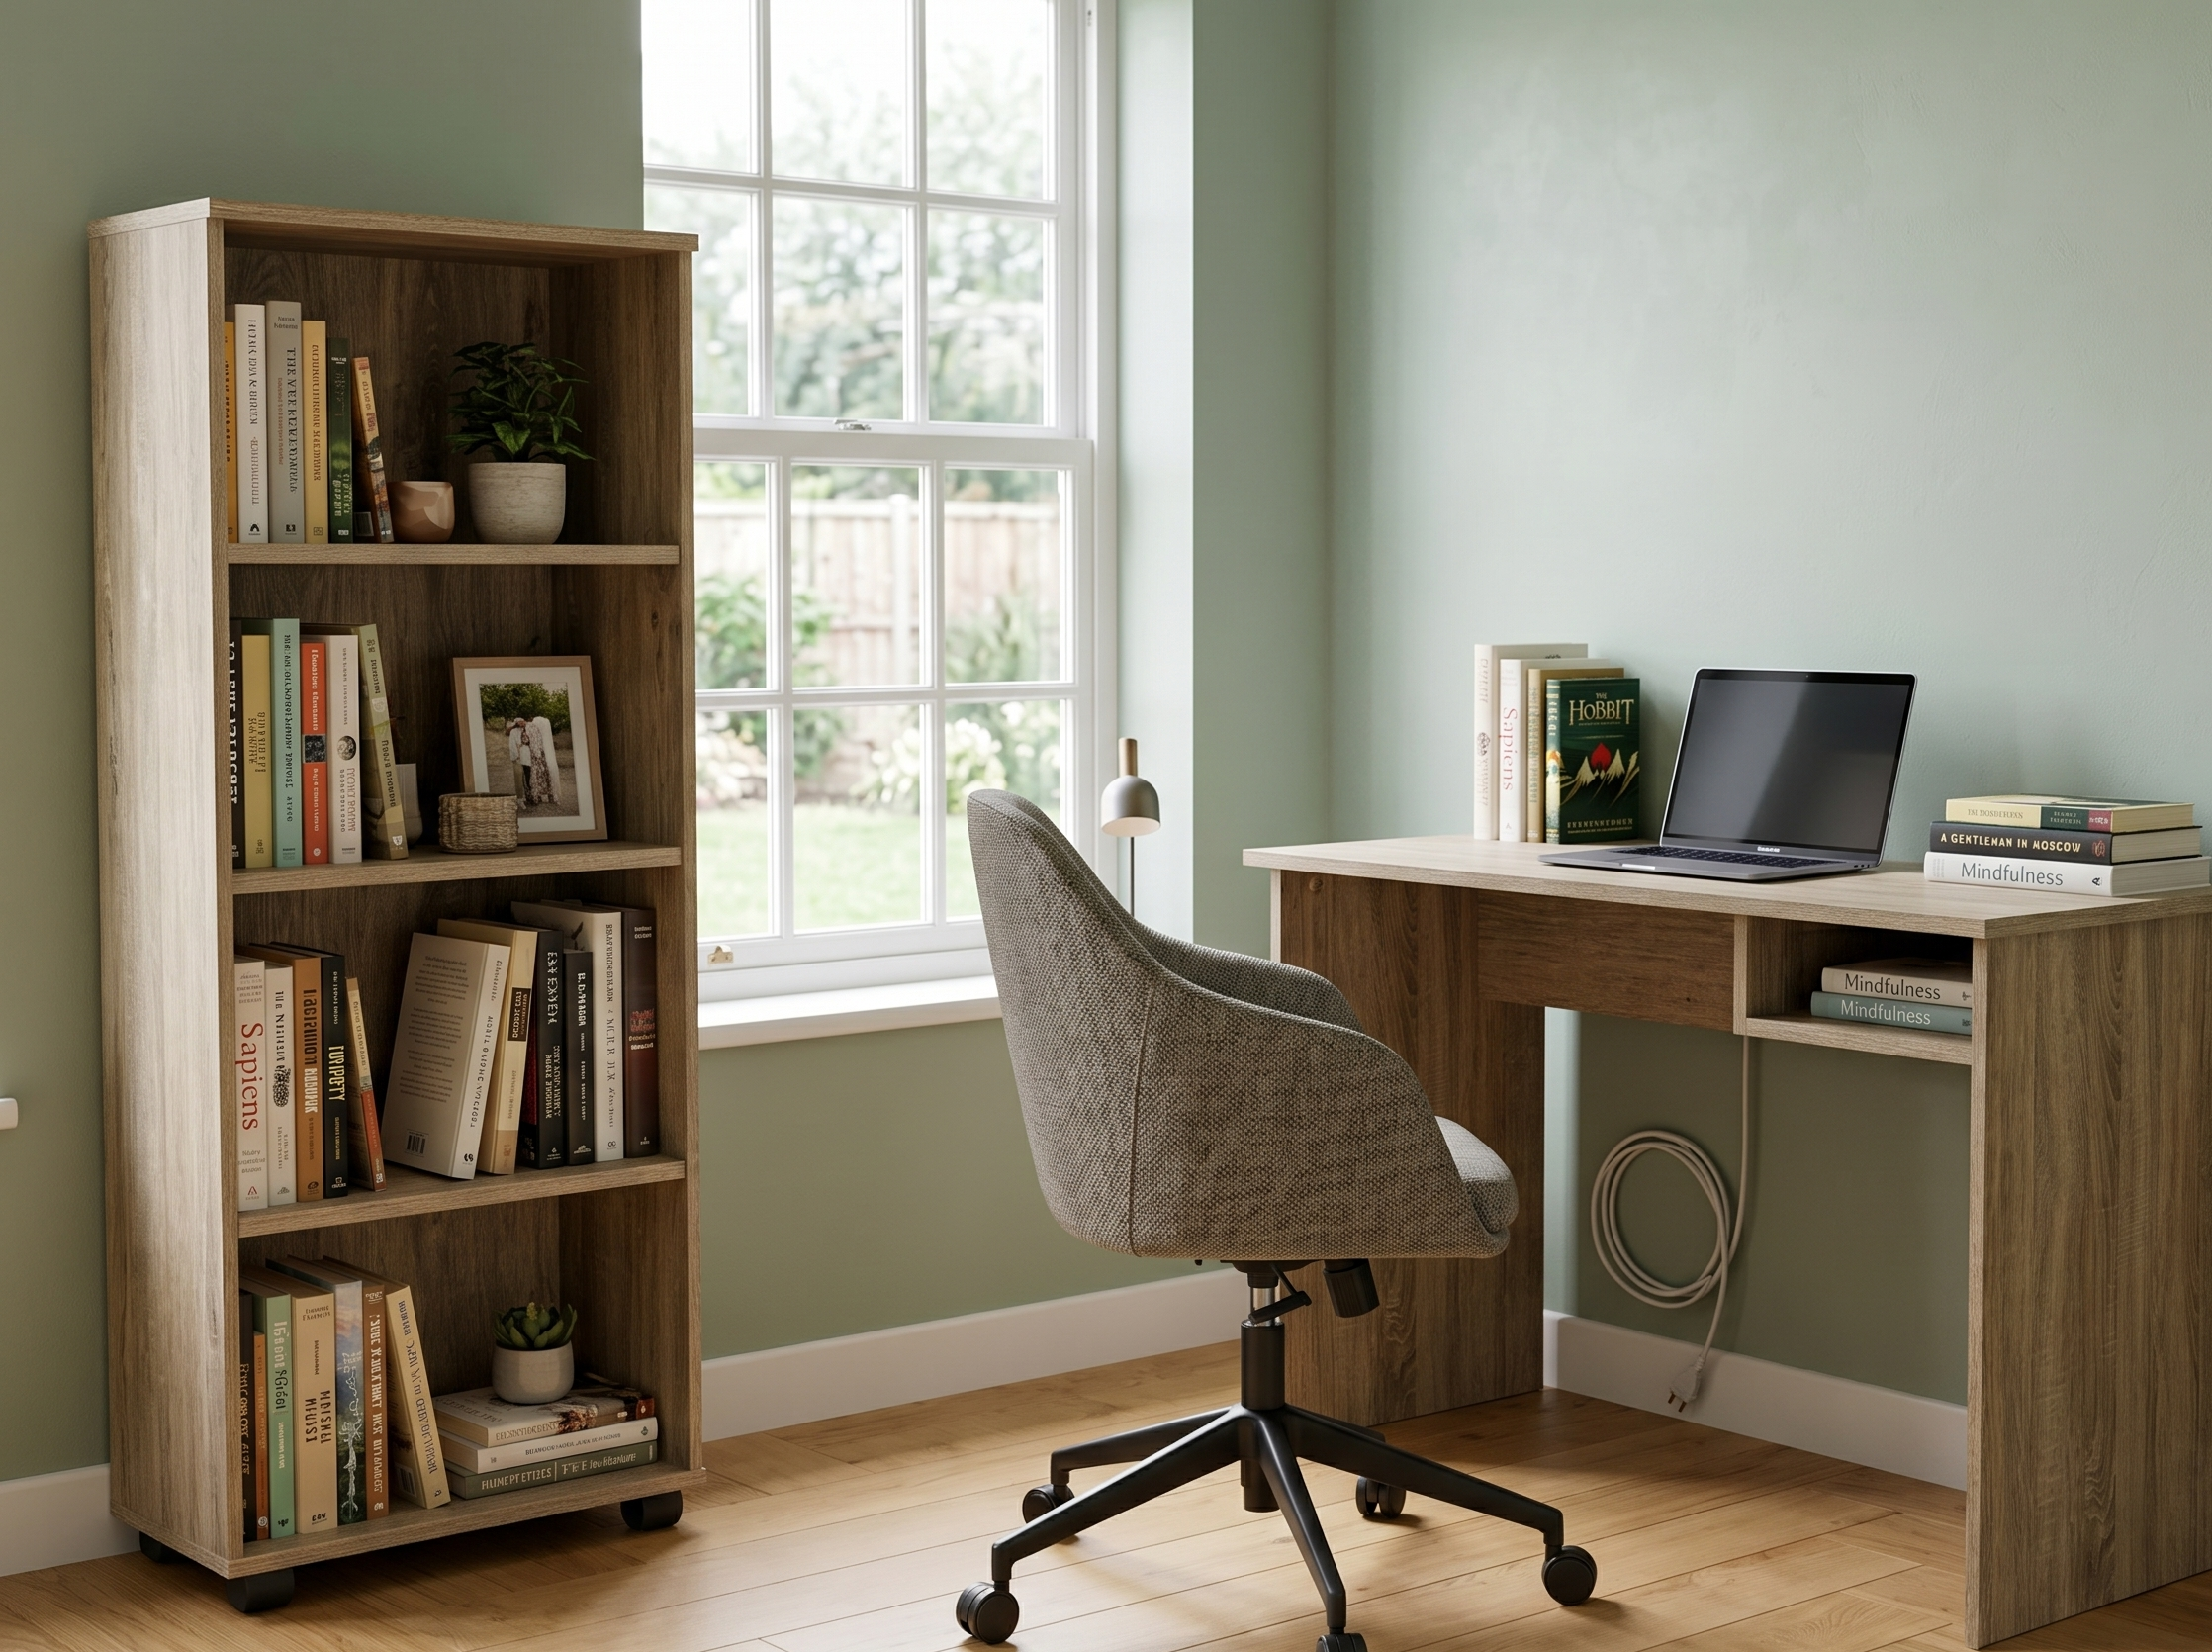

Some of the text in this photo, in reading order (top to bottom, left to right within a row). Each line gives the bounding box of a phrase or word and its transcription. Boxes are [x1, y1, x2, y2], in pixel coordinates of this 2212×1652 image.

[1498, 707, 1518, 791] Sapiens
[1940, 833, 2081, 853] A GENTLEMAN IN MOSCOW
[1961, 862, 2064, 886] Mindfulness
[1844, 973, 1941, 1000] Mindfulness
[1841, 999, 1931, 1026] Mindfulness
[235, 1022, 264, 1131] Sapiens
